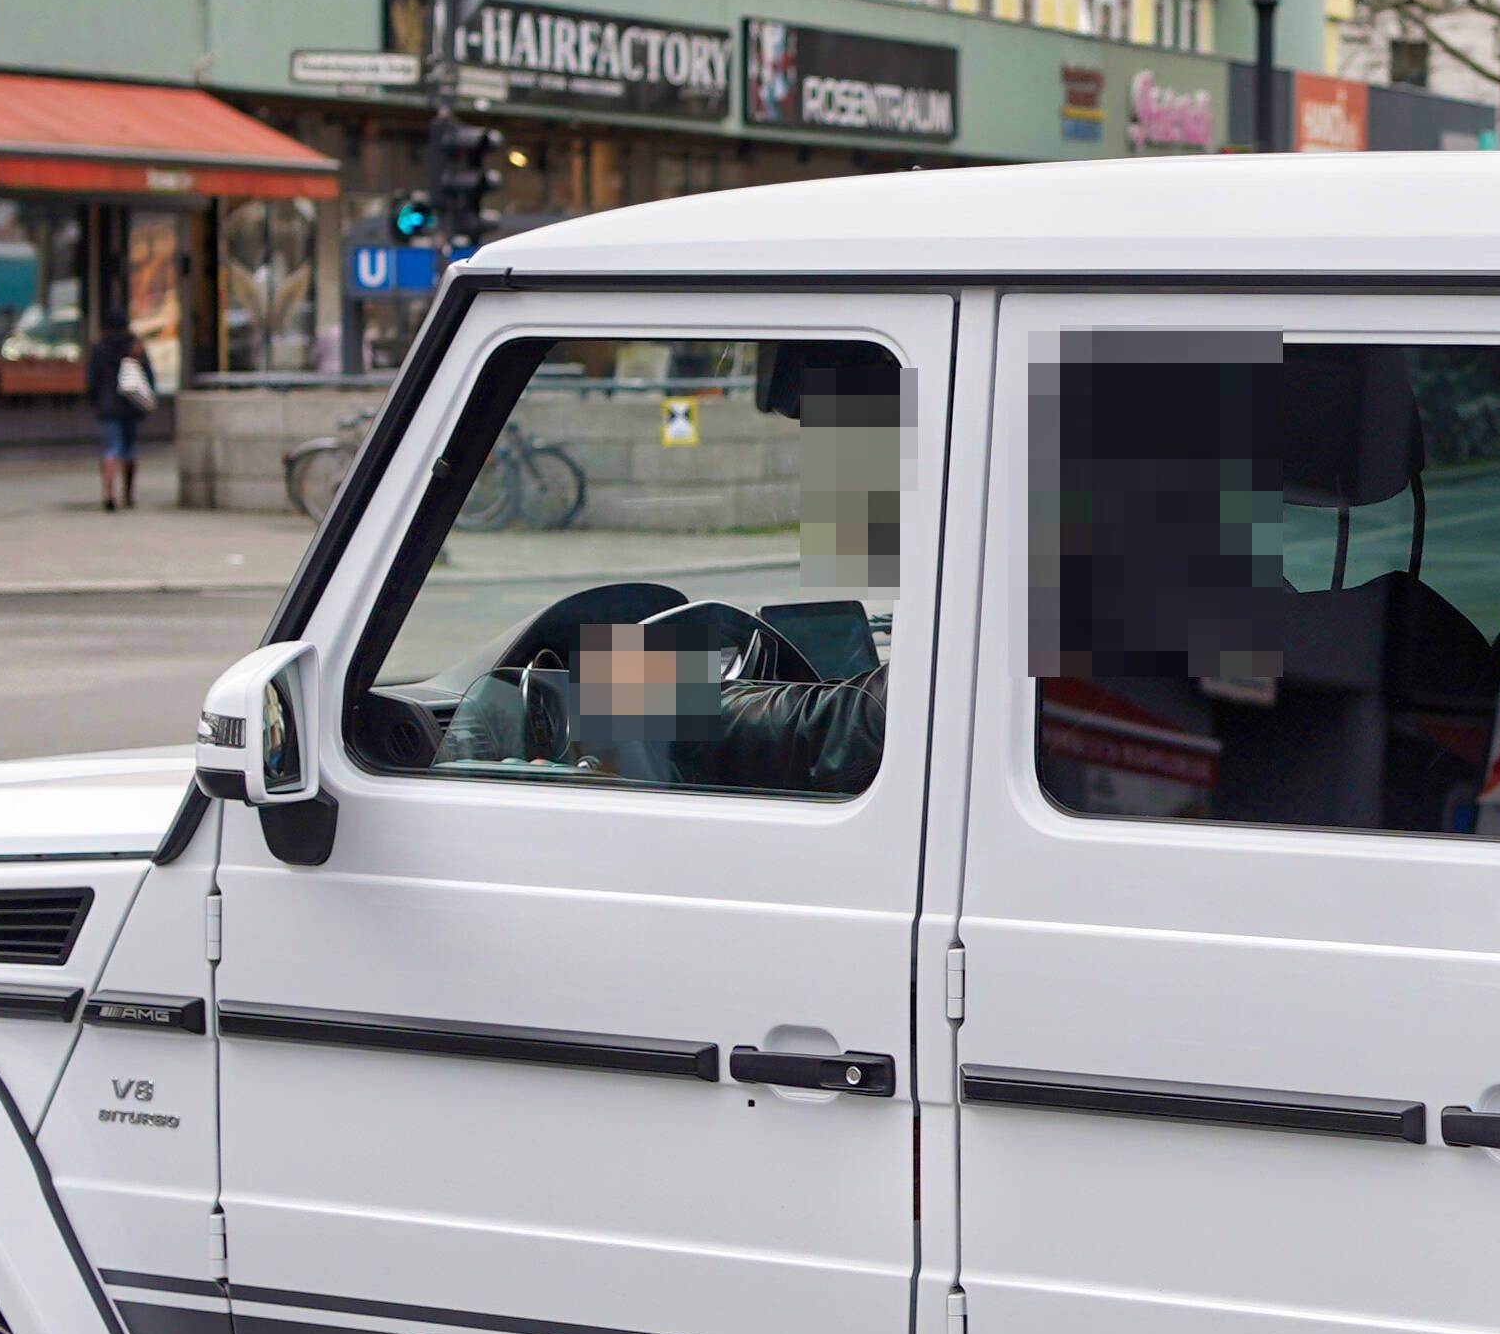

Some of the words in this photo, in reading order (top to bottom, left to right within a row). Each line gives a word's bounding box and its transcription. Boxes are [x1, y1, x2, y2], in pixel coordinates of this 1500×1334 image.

[802, 75, 954, 133] ROSENTRAUM
[357, 247, 388, 288] U
[119, 1008, 171, 1023] AMG
[110, 1077, 156, 1102] V8
[98, 1108, 182, 1130] BITURBO
